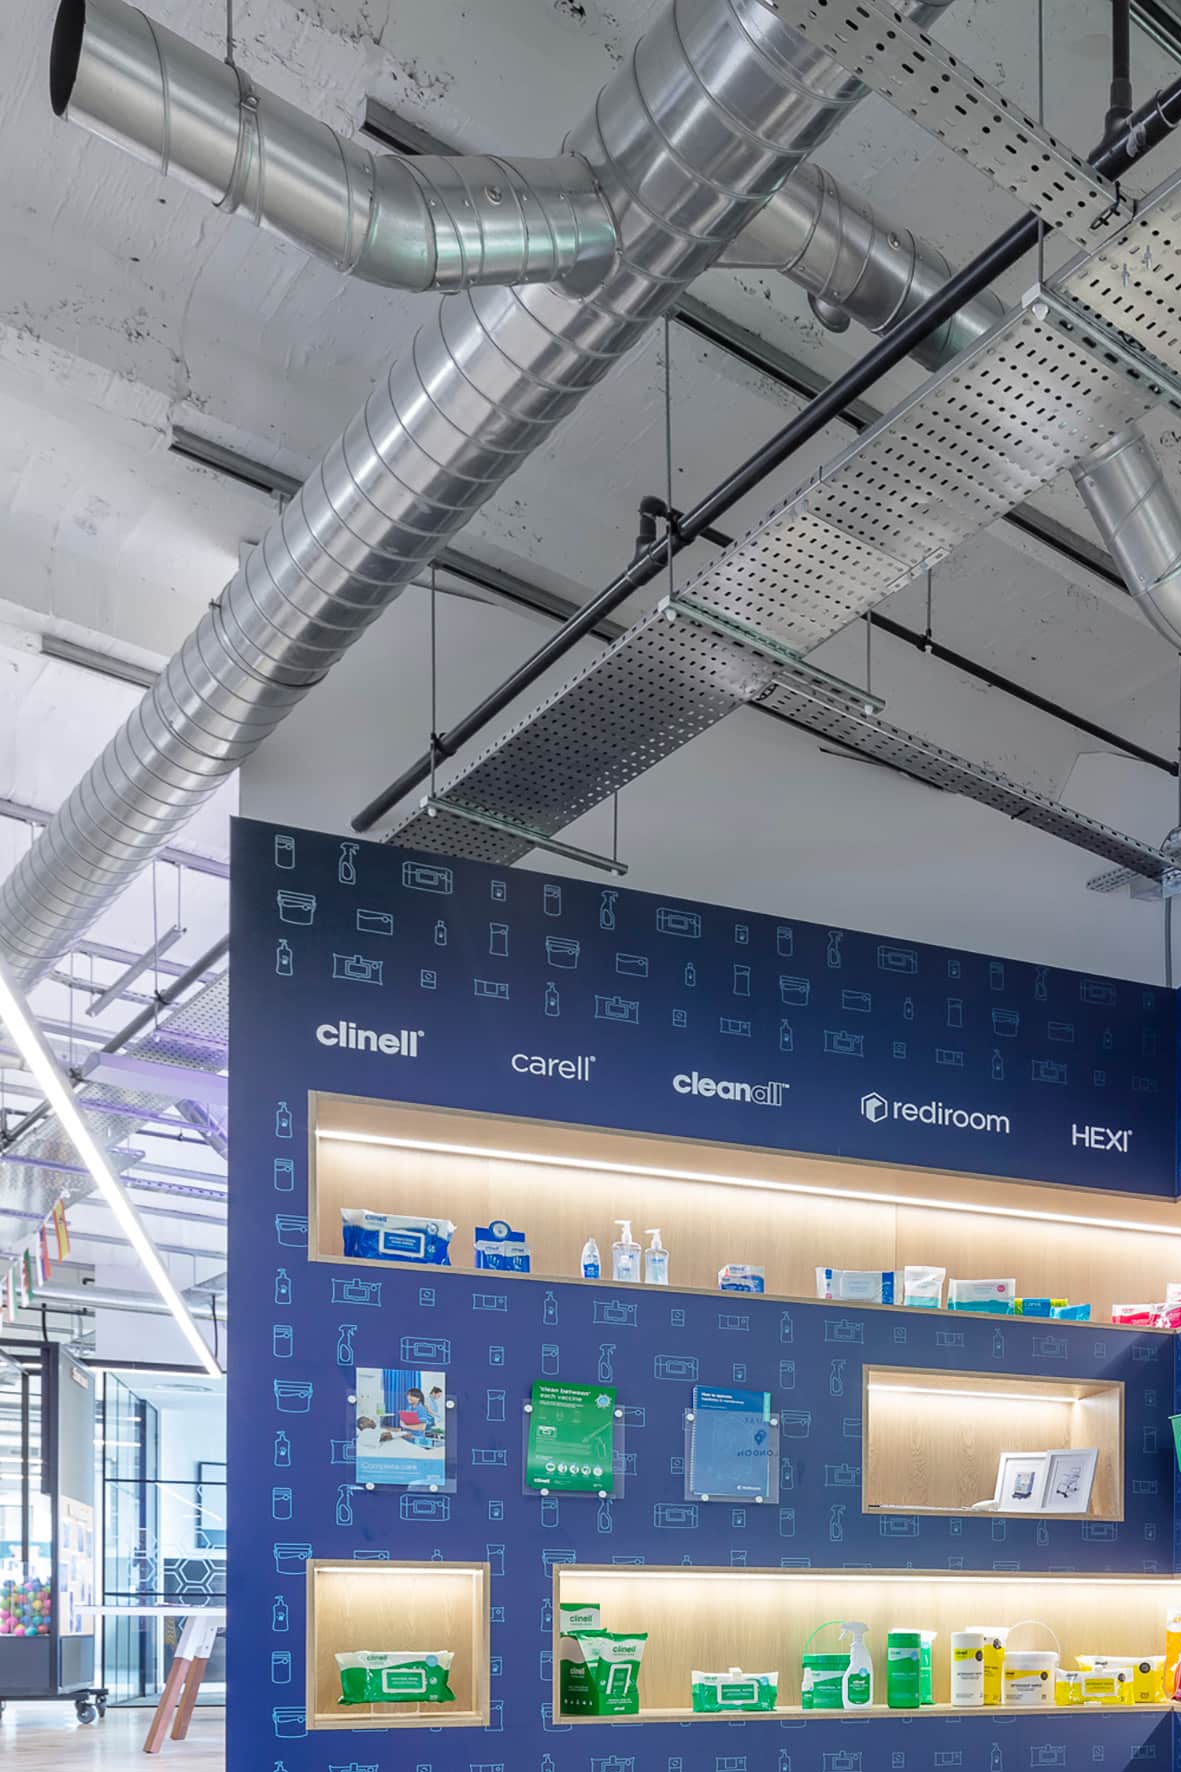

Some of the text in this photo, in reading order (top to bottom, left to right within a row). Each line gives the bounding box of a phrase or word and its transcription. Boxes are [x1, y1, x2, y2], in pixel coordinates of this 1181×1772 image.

[315, 1020, 425, 1057] clinell
[511, 1053, 596, 1081] carell
[893, 1101, 1010, 1134] rediroom
